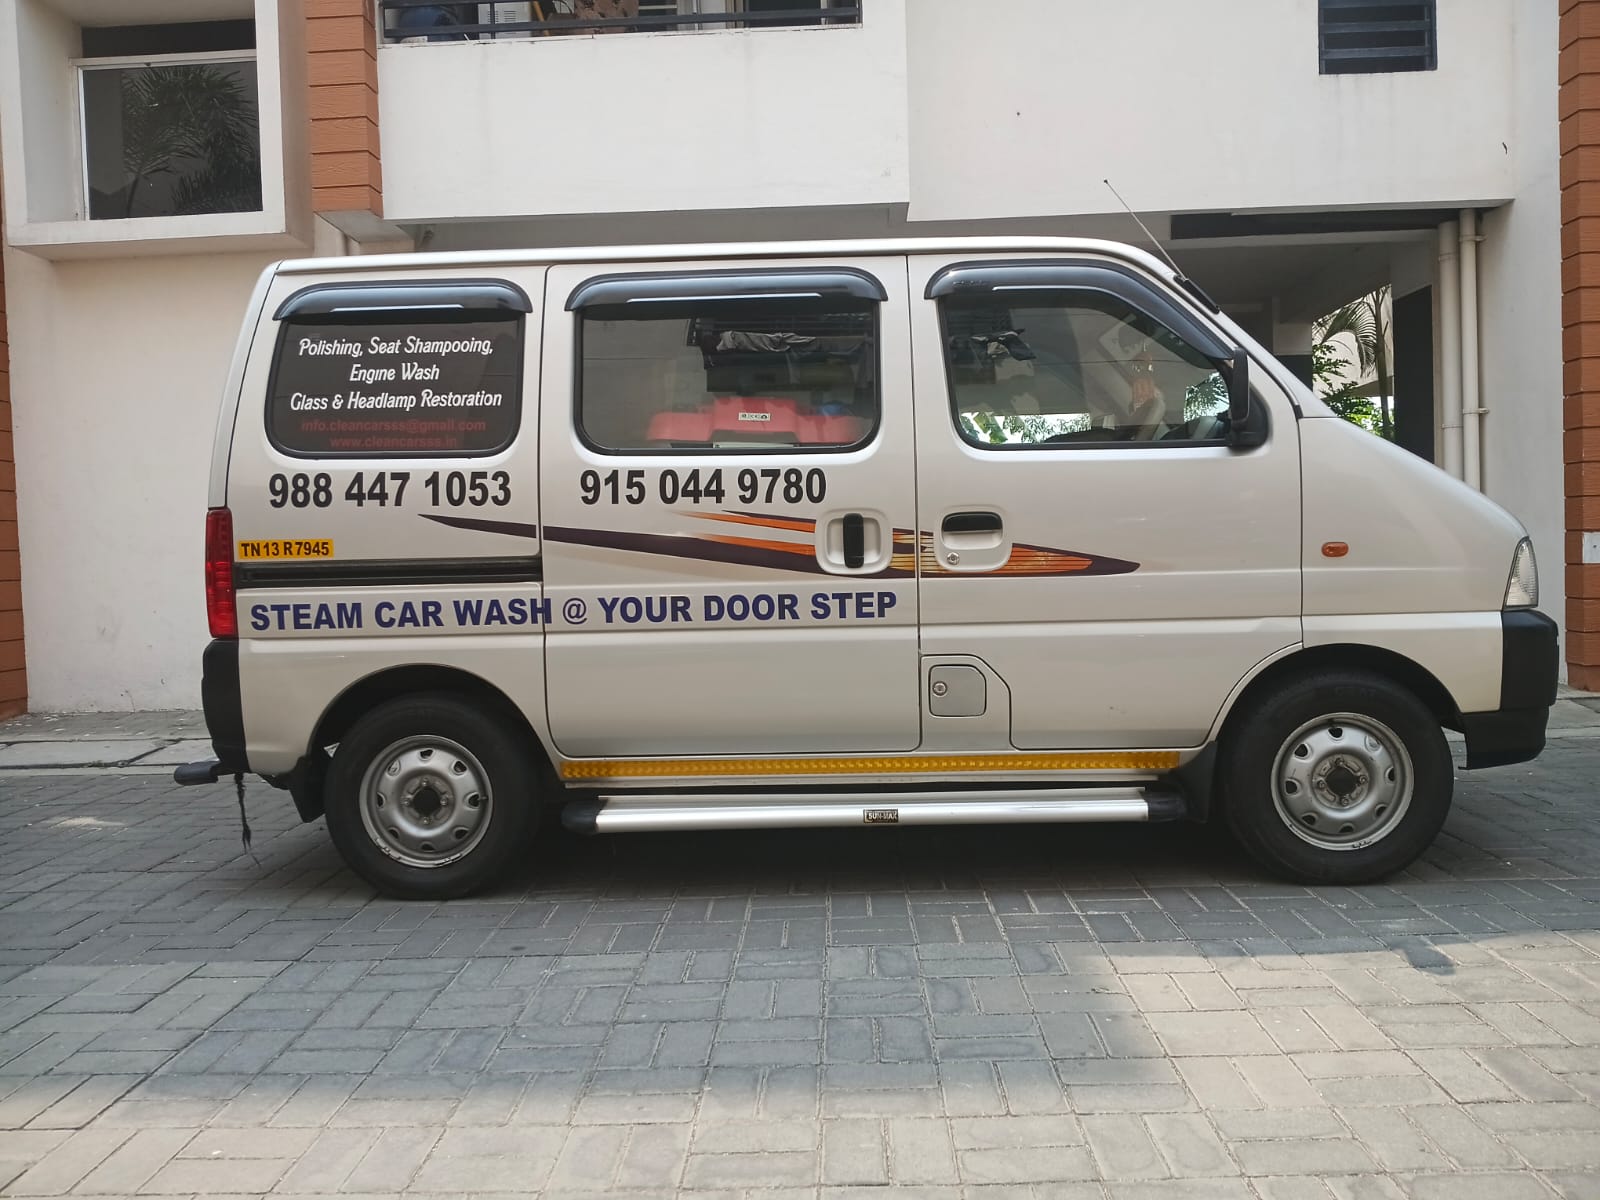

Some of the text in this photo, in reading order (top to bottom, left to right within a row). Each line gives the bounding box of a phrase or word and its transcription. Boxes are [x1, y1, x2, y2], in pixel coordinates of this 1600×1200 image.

[299, 336, 493, 358] Polishing, Seat Shampooing,
[350, 362, 440, 382] Engine Wash
[290, 389, 502, 411] Glass & Headlamp Restoration
[269, 471, 511, 508] 988 447 1053
[581, 468, 827, 505] 915 044 9780
[241, 542, 330, 557] TN 13 R 7945
[251, 592, 896, 630] STEAM CAR WASH @ YOUR DOOR STEP
